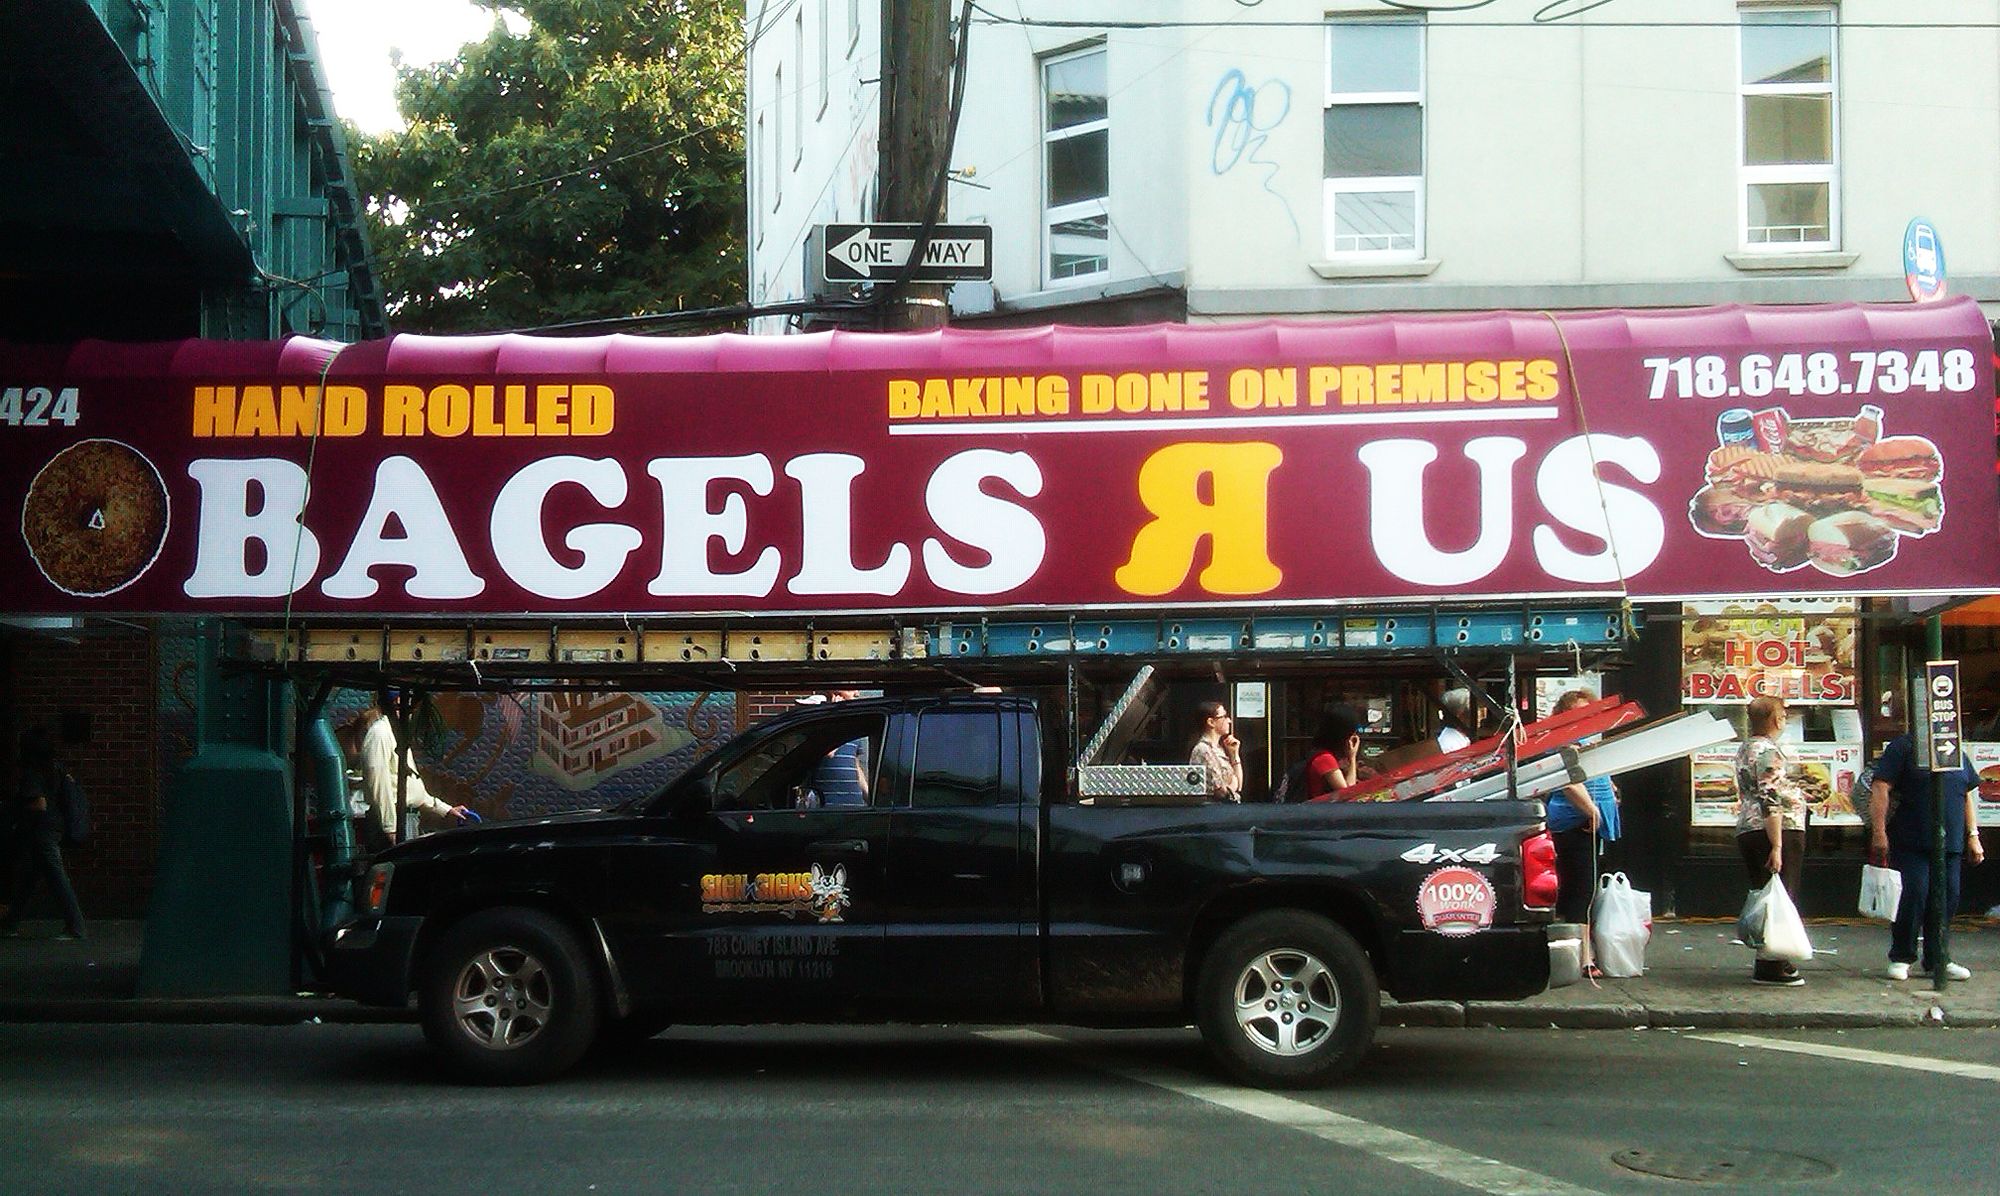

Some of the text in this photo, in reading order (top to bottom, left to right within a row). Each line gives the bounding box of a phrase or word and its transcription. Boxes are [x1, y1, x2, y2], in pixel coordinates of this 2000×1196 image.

[849, 242, 972, 264] ONE WAY
[1643, 348, 1976, 399] 718.648.7348
[888, 359, 1559, 419] BAKING DONE ON PREMISES
[0, 387, 80, 426] 424
[193, 385, 615, 437] HAND ROLLED
[183, 449, 1046, 599] BAGELS
[1357, 433, 1666, 586] US
[1724, 640, 1811, 668] HOT
[1690, 672, 1845, 700] BAGELS
[1931, 711, 1957, 722] STOP
[1933, 700, 1954, 710] BUS
[1400, 843, 1501, 865] 4x4
[1427, 883, 1485, 902] 100%
[731, 936, 770, 955] CONEY
[773, 936, 813, 955] ISLAND
[778, 959, 795, 977] NY
